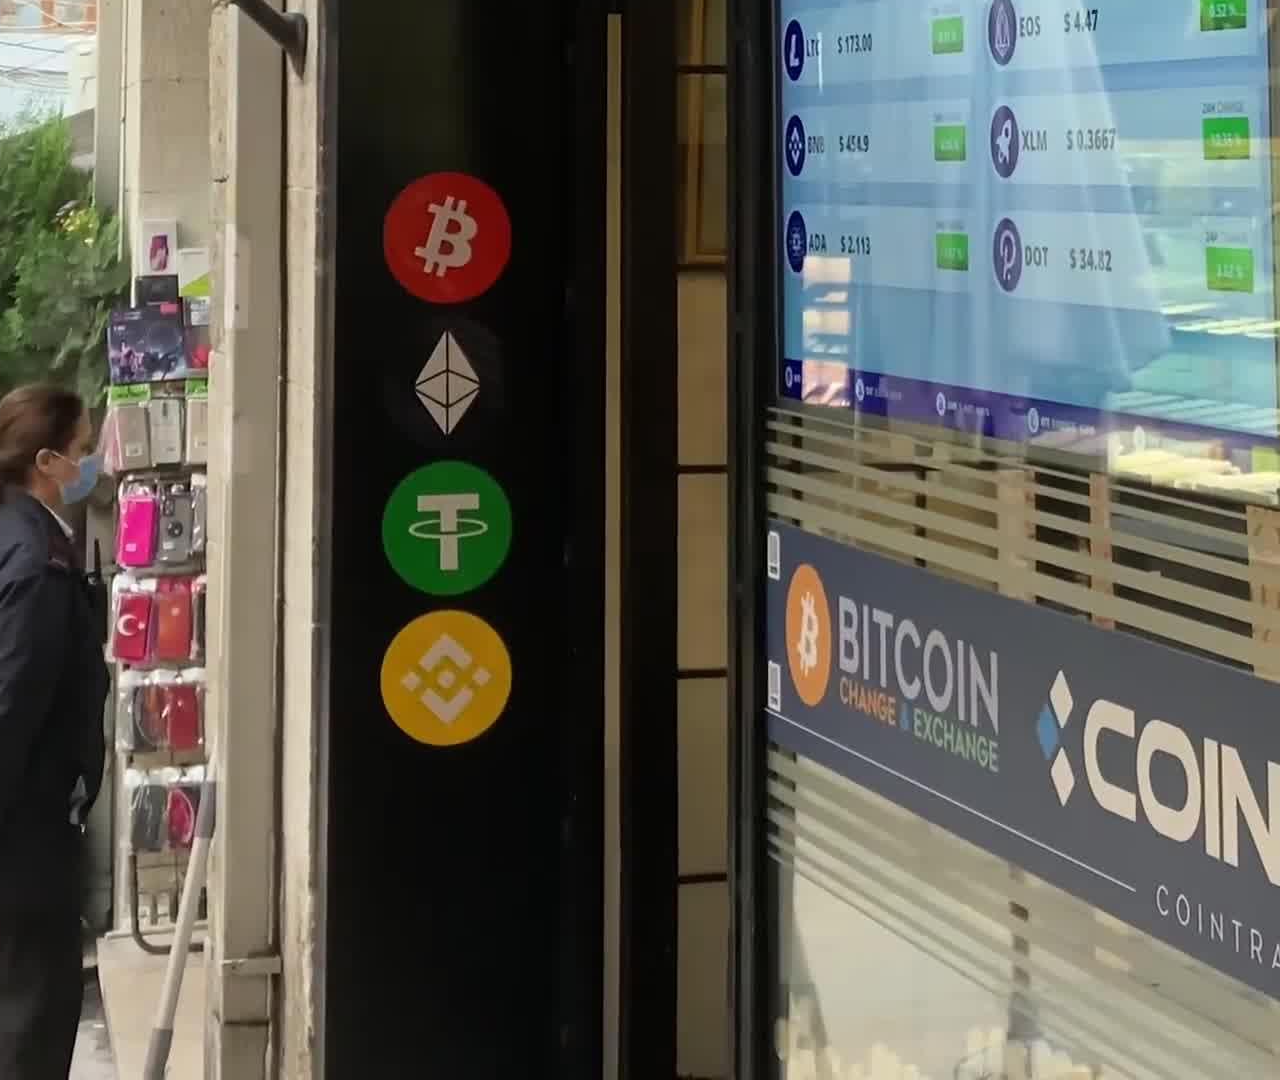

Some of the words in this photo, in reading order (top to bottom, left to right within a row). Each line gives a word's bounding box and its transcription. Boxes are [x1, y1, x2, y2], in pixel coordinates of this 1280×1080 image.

[1020, 16, 1041, 37] EOS
[1073, 10, 1099, 32] 4.47
[1022, 130, 1047, 152] XLM
[1076, 128, 1117, 151] 0.3667
[1024, 245, 1049, 267] DOT
[1080, 250, 1112, 272] 34.82
[838, 595, 999, 734] BITCOIN
[839, 675, 896, 727] CHANGE
[913, 709, 999, 772] EXCHANGE
